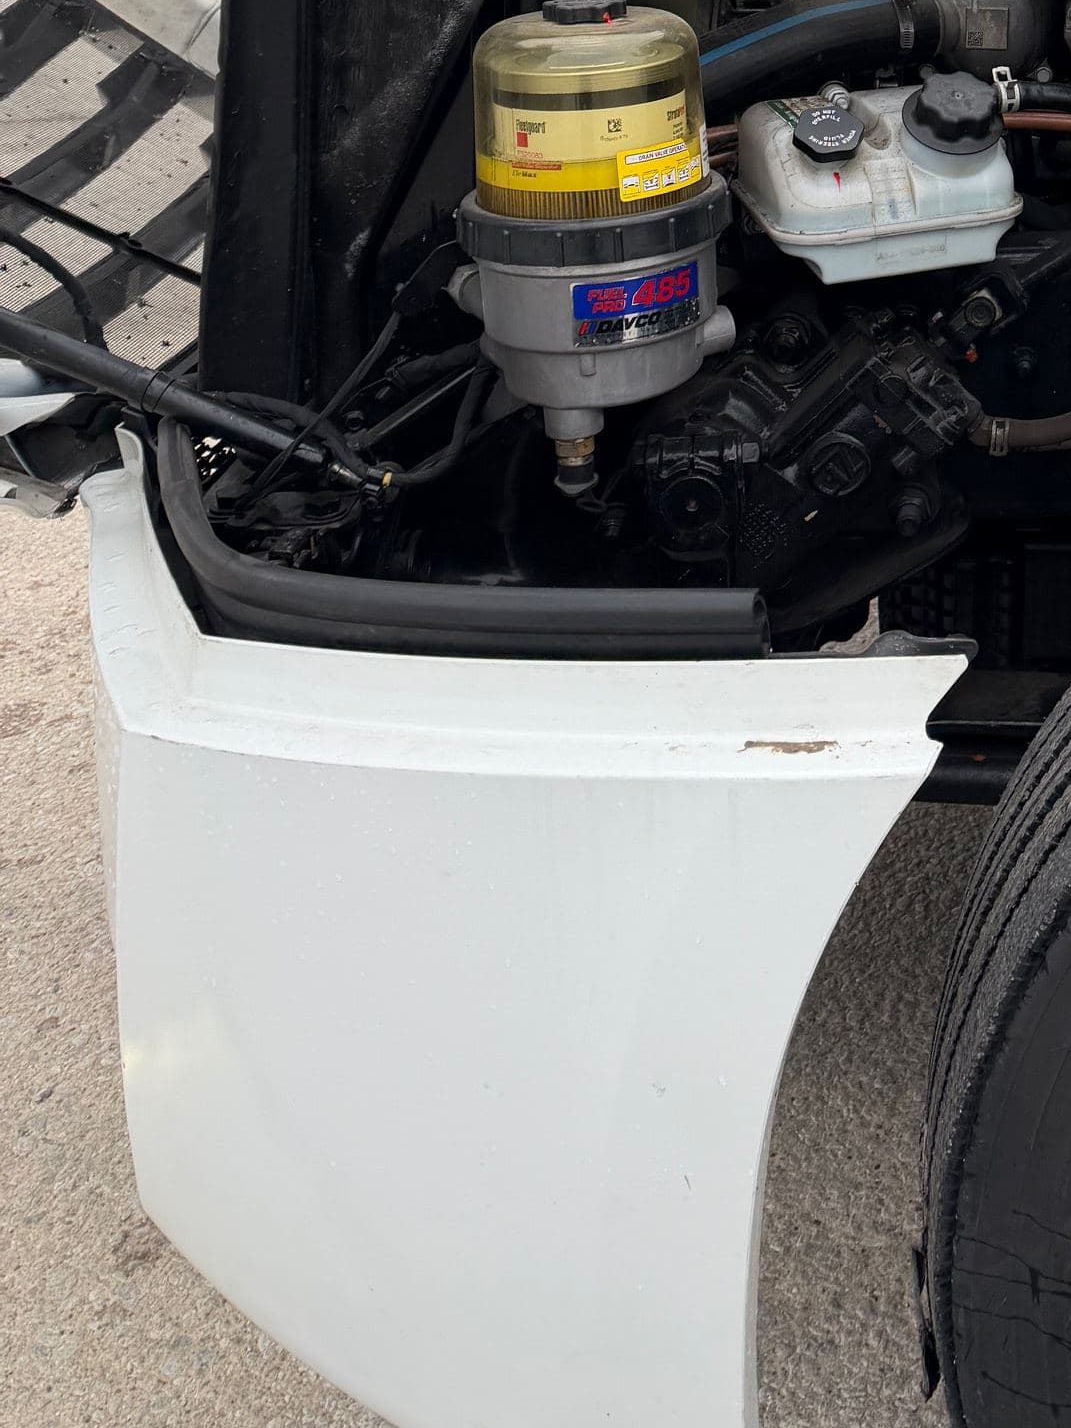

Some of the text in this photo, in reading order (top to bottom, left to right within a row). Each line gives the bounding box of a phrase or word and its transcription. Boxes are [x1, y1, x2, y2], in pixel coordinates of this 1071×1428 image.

[516, 119, 546, 135] Fleetguard
[638, 152, 654, 161] DRAIN
[654, 149, 669, 158] VALVE
[587, 287, 625, 301] FUEL
[632, 269, 691, 307] 485
[592, 299, 625, 314] PRO
[597, 312, 662, 334] DAVCO
